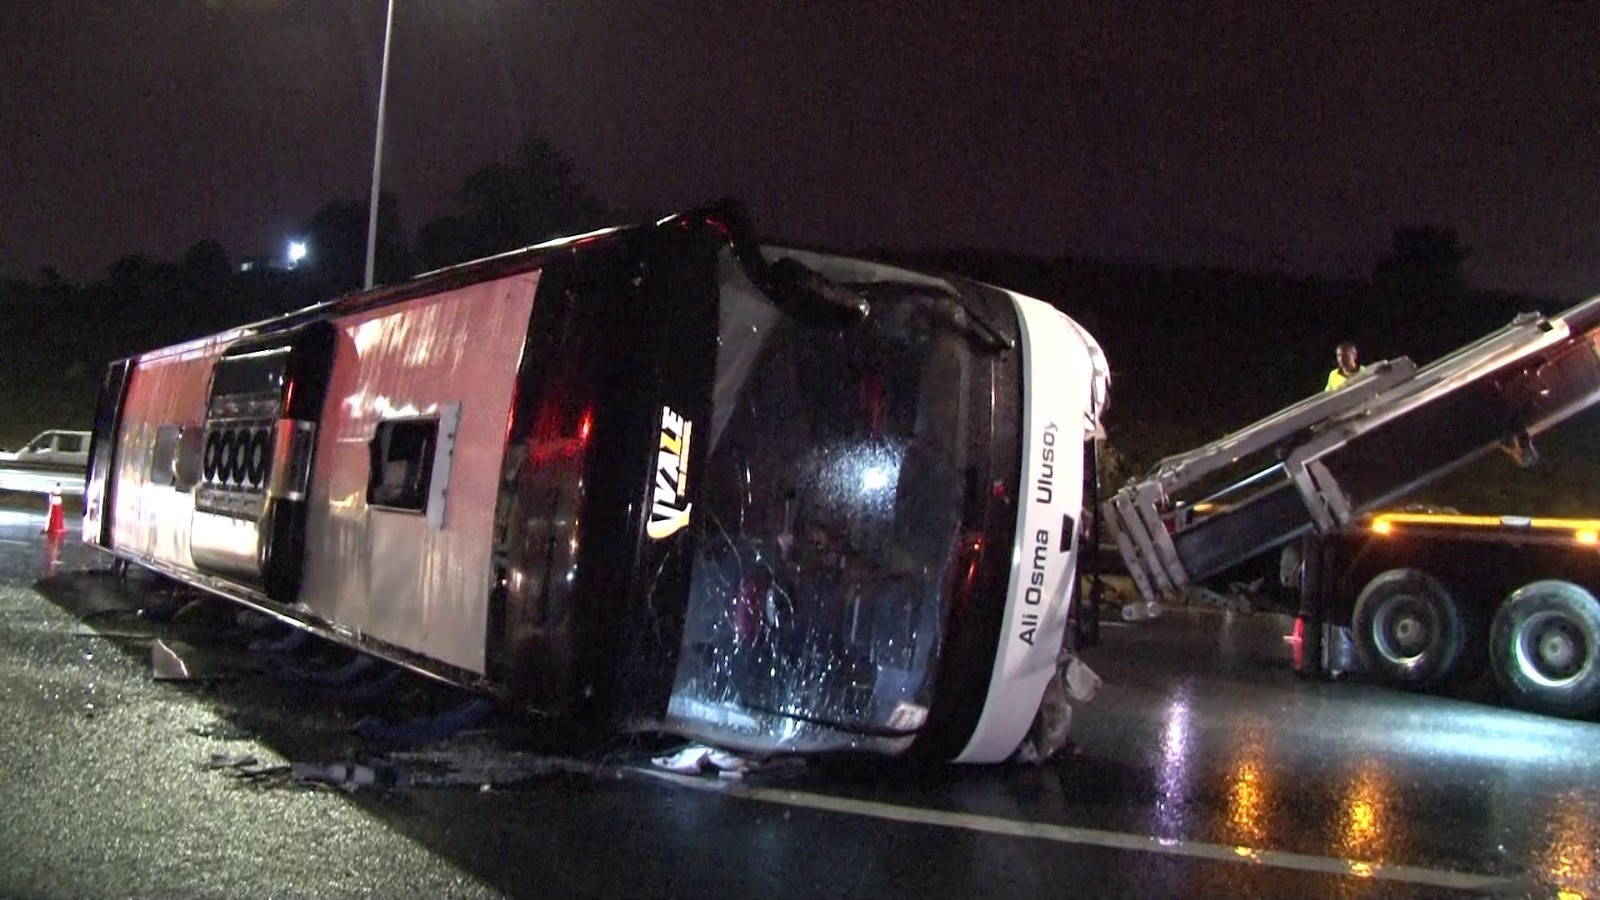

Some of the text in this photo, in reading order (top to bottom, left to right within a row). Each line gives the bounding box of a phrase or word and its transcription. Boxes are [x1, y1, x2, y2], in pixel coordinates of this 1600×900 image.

[1019, 420, 1059, 646] Ali Osma Ulusoy
